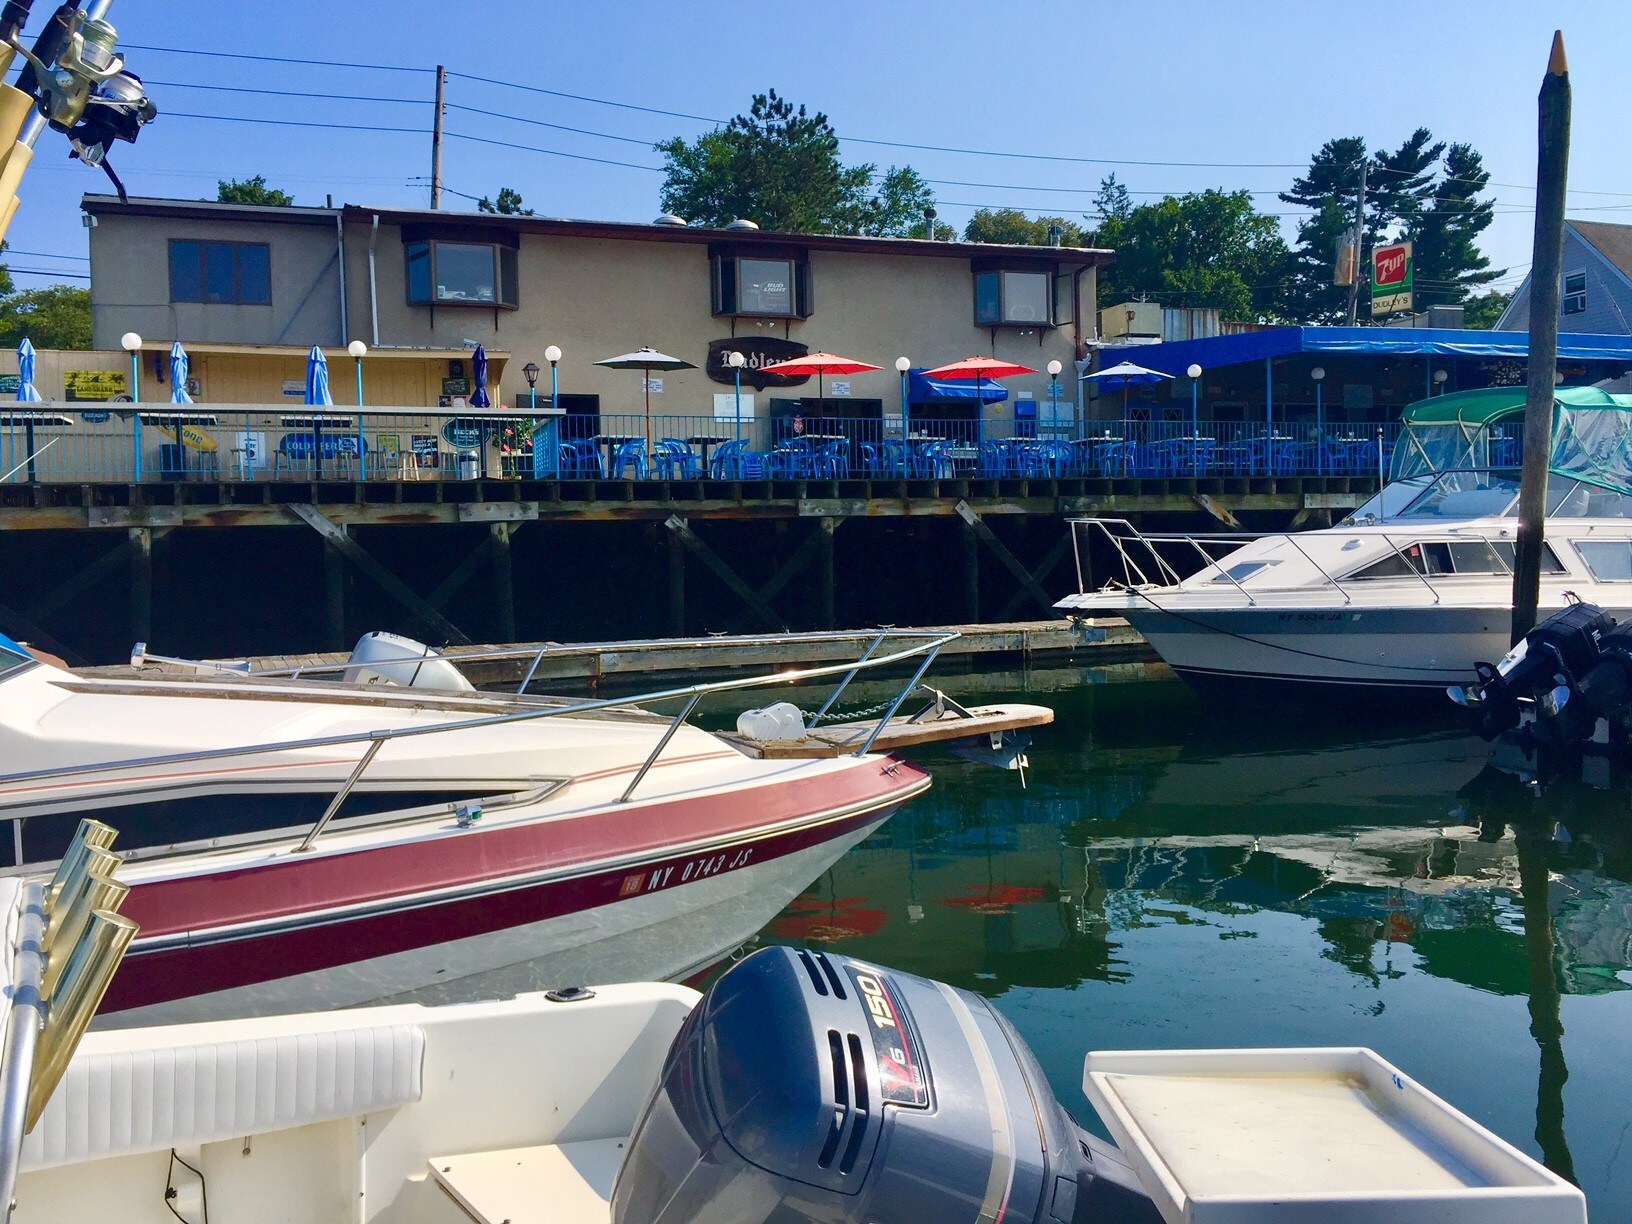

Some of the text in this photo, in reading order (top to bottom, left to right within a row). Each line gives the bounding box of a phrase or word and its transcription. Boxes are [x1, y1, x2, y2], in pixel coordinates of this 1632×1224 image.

[1373, 296, 1408, 309] DUDLEY'S
[286, 442, 310, 450] COLD
[313, 442, 338, 450] EER
[647, 866, 674, 890] NY
[681, 854, 726, 881] 0743
[729, 848, 753, 869] JS
[857, 975, 896, 1028] 150
